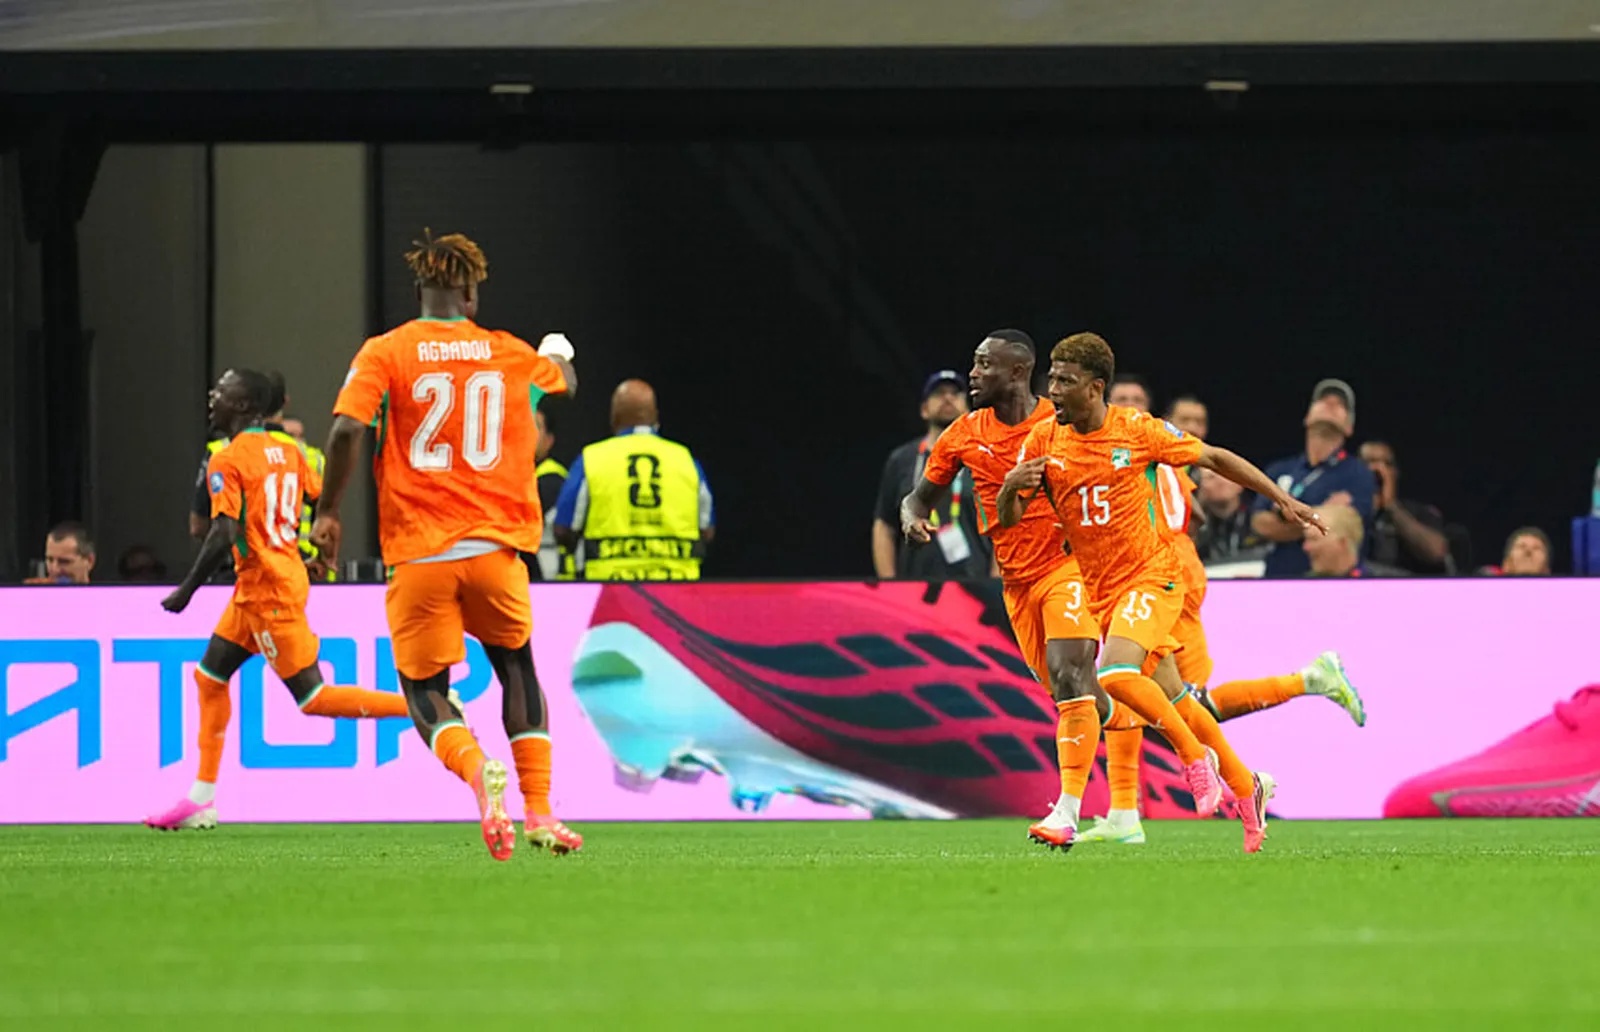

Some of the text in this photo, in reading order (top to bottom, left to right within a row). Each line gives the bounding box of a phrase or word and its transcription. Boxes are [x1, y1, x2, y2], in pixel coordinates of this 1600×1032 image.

[417, 340, 492, 362] AGBADOU
[409, 370, 506, 472] 20
[263, 472, 299, 548] 19
[1078, 485, 1111, 526] 15
[1065, 581, 1082, 610] 3
[1121, 591, 1157, 621] 15
